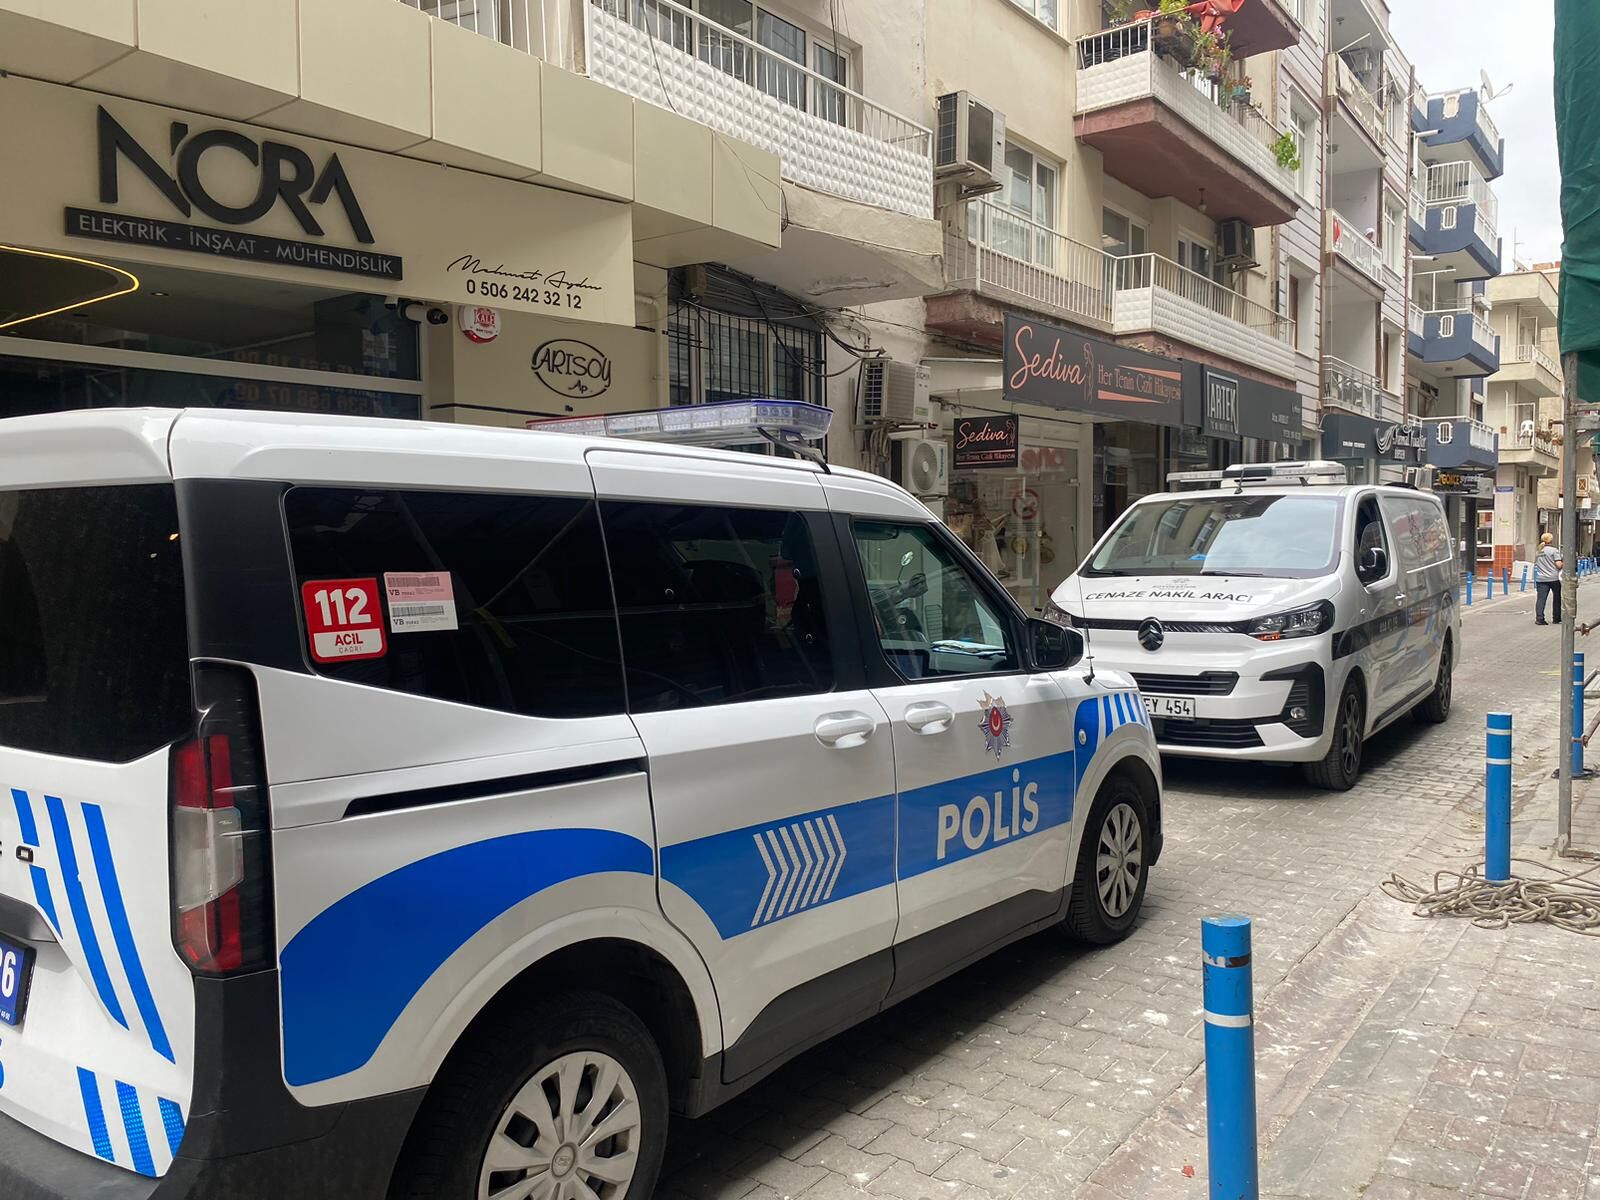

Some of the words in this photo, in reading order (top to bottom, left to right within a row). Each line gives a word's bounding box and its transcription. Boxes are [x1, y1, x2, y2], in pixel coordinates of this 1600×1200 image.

[79, 214, 168, 242] ELEKTRİK
[189, 227, 257, 255] İNŞAAT
[276, 243, 393, 274] MÜHENDİSLİK
[466, 279, 476, 294] 0
[480, 281, 508, 299] 506
[512, 285, 539, 303] 242
[543, 290, 561, 306] 32
[566, 293, 582, 309] 12
[1010, 325, 1086, 390] Sediva
[956, 421, 1008, 449] Sediva
[314, 587, 372, 626] 112
[1085, 590, 1145, 601] CENAZE
[1149, 590, 1197, 599] NAKİL
[1200, 592, 1254, 603] ARACI
[335, 633, 364, 647] ACİL
[1166, 699, 1191, 716] 454
[937, 767, 1040, 861] POLİS
